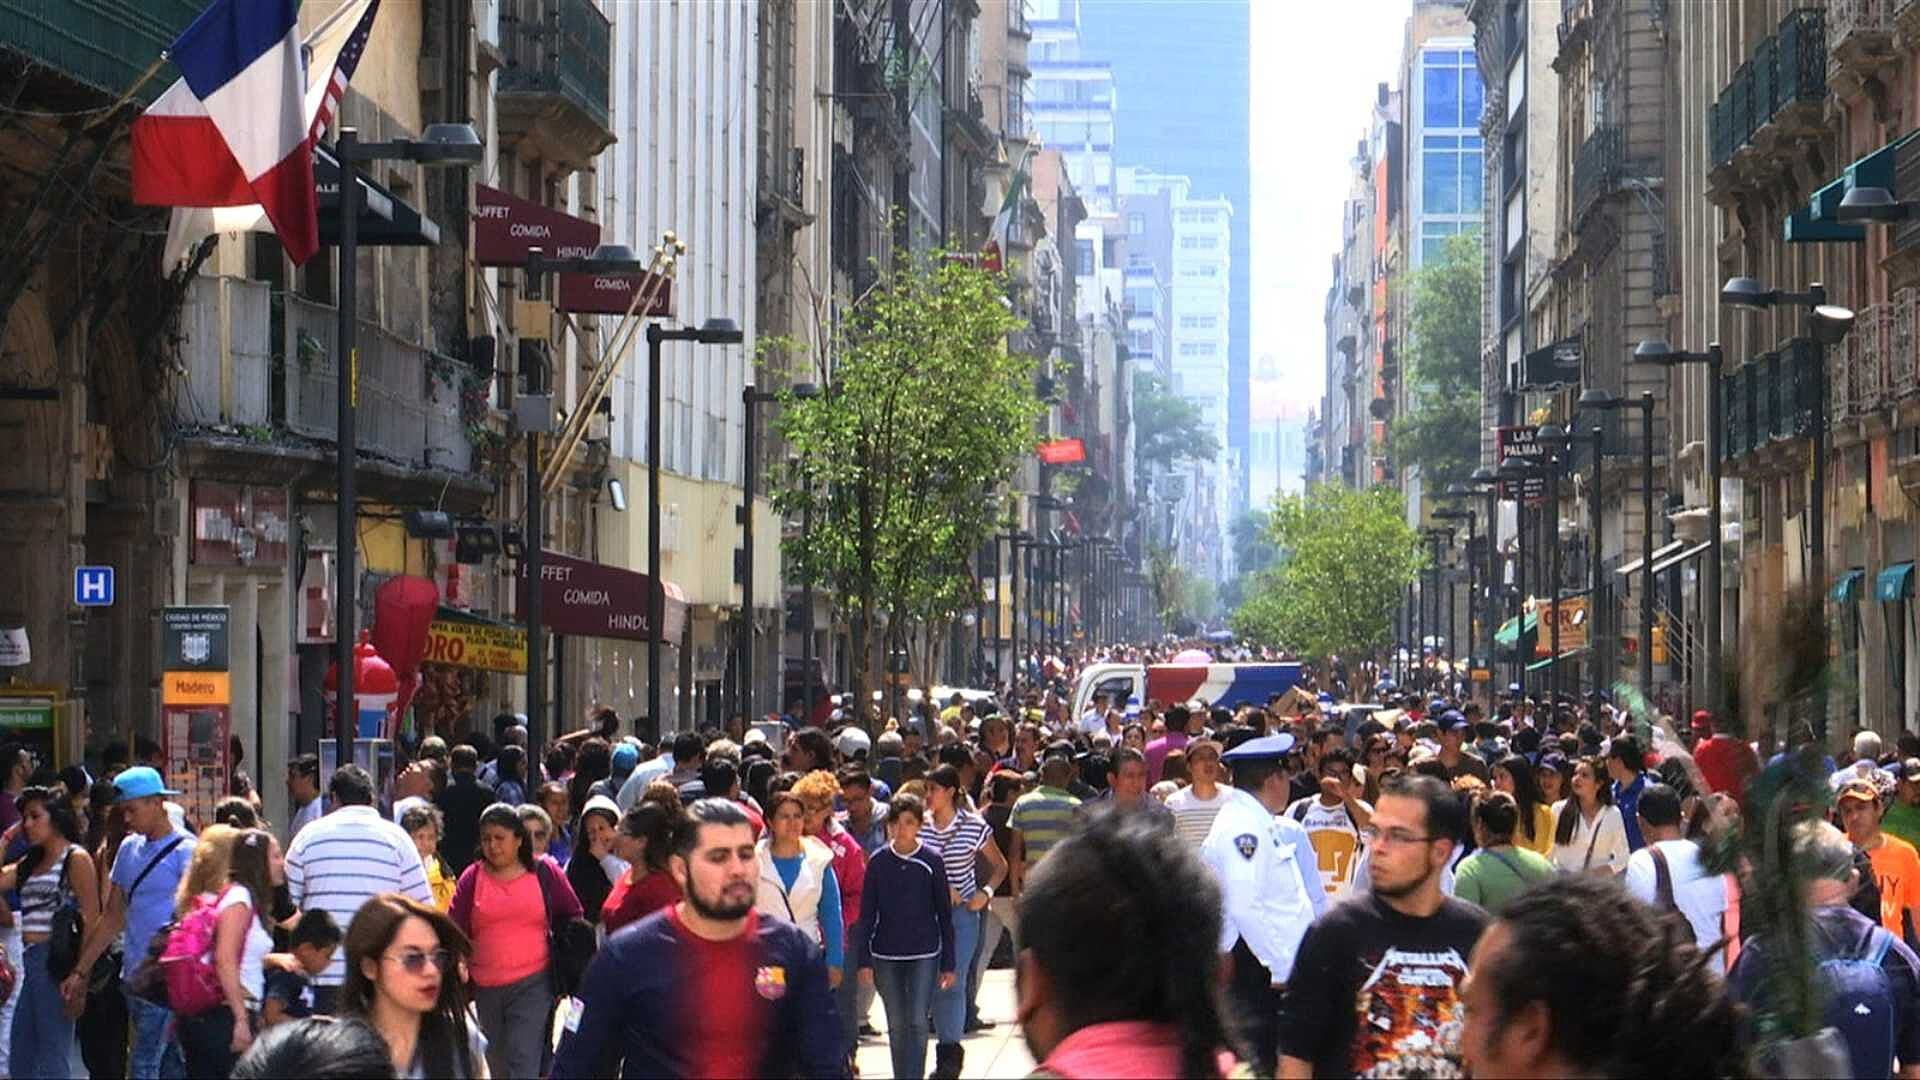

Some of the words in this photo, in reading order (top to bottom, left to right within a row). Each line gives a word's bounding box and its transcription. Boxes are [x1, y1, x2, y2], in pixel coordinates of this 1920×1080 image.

[478, 205, 511, 219] UFFET
[510, 224, 551, 238] COMIDA
[556, 247, 593, 260] HINDU
[594, 278, 631, 291] COMIDA
[1512, 430, 1534, 443] LAS
[1503, 444, 1545, 457] PALMAS
[522, 563, 573, 581] BFFET
[83, 572, 105, 600] H
[563, 588, 611, 607] COMIDA
[175, 680, 215, 694] Madero
